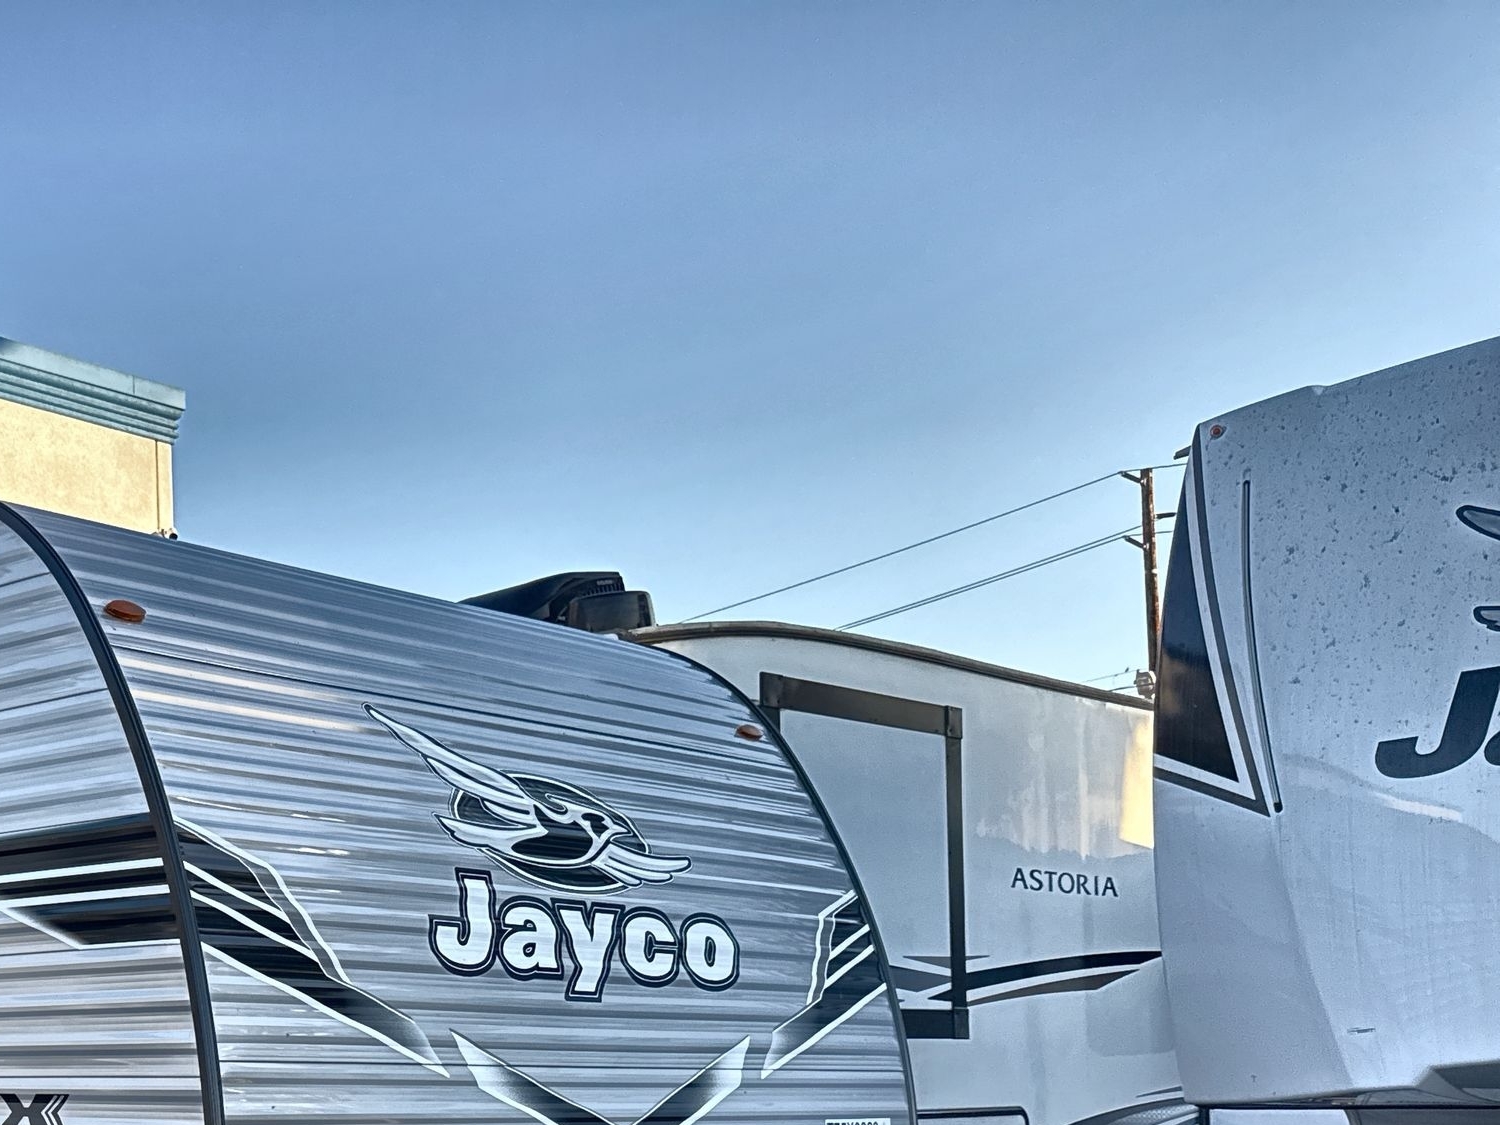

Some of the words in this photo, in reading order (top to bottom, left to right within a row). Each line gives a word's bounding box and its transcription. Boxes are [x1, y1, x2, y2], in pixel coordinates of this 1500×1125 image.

[1375, 666, 1500, 779] J
[429, 867, 739, 1002] Jayco
[1011, 867, 1119, 897] ASTORIA
